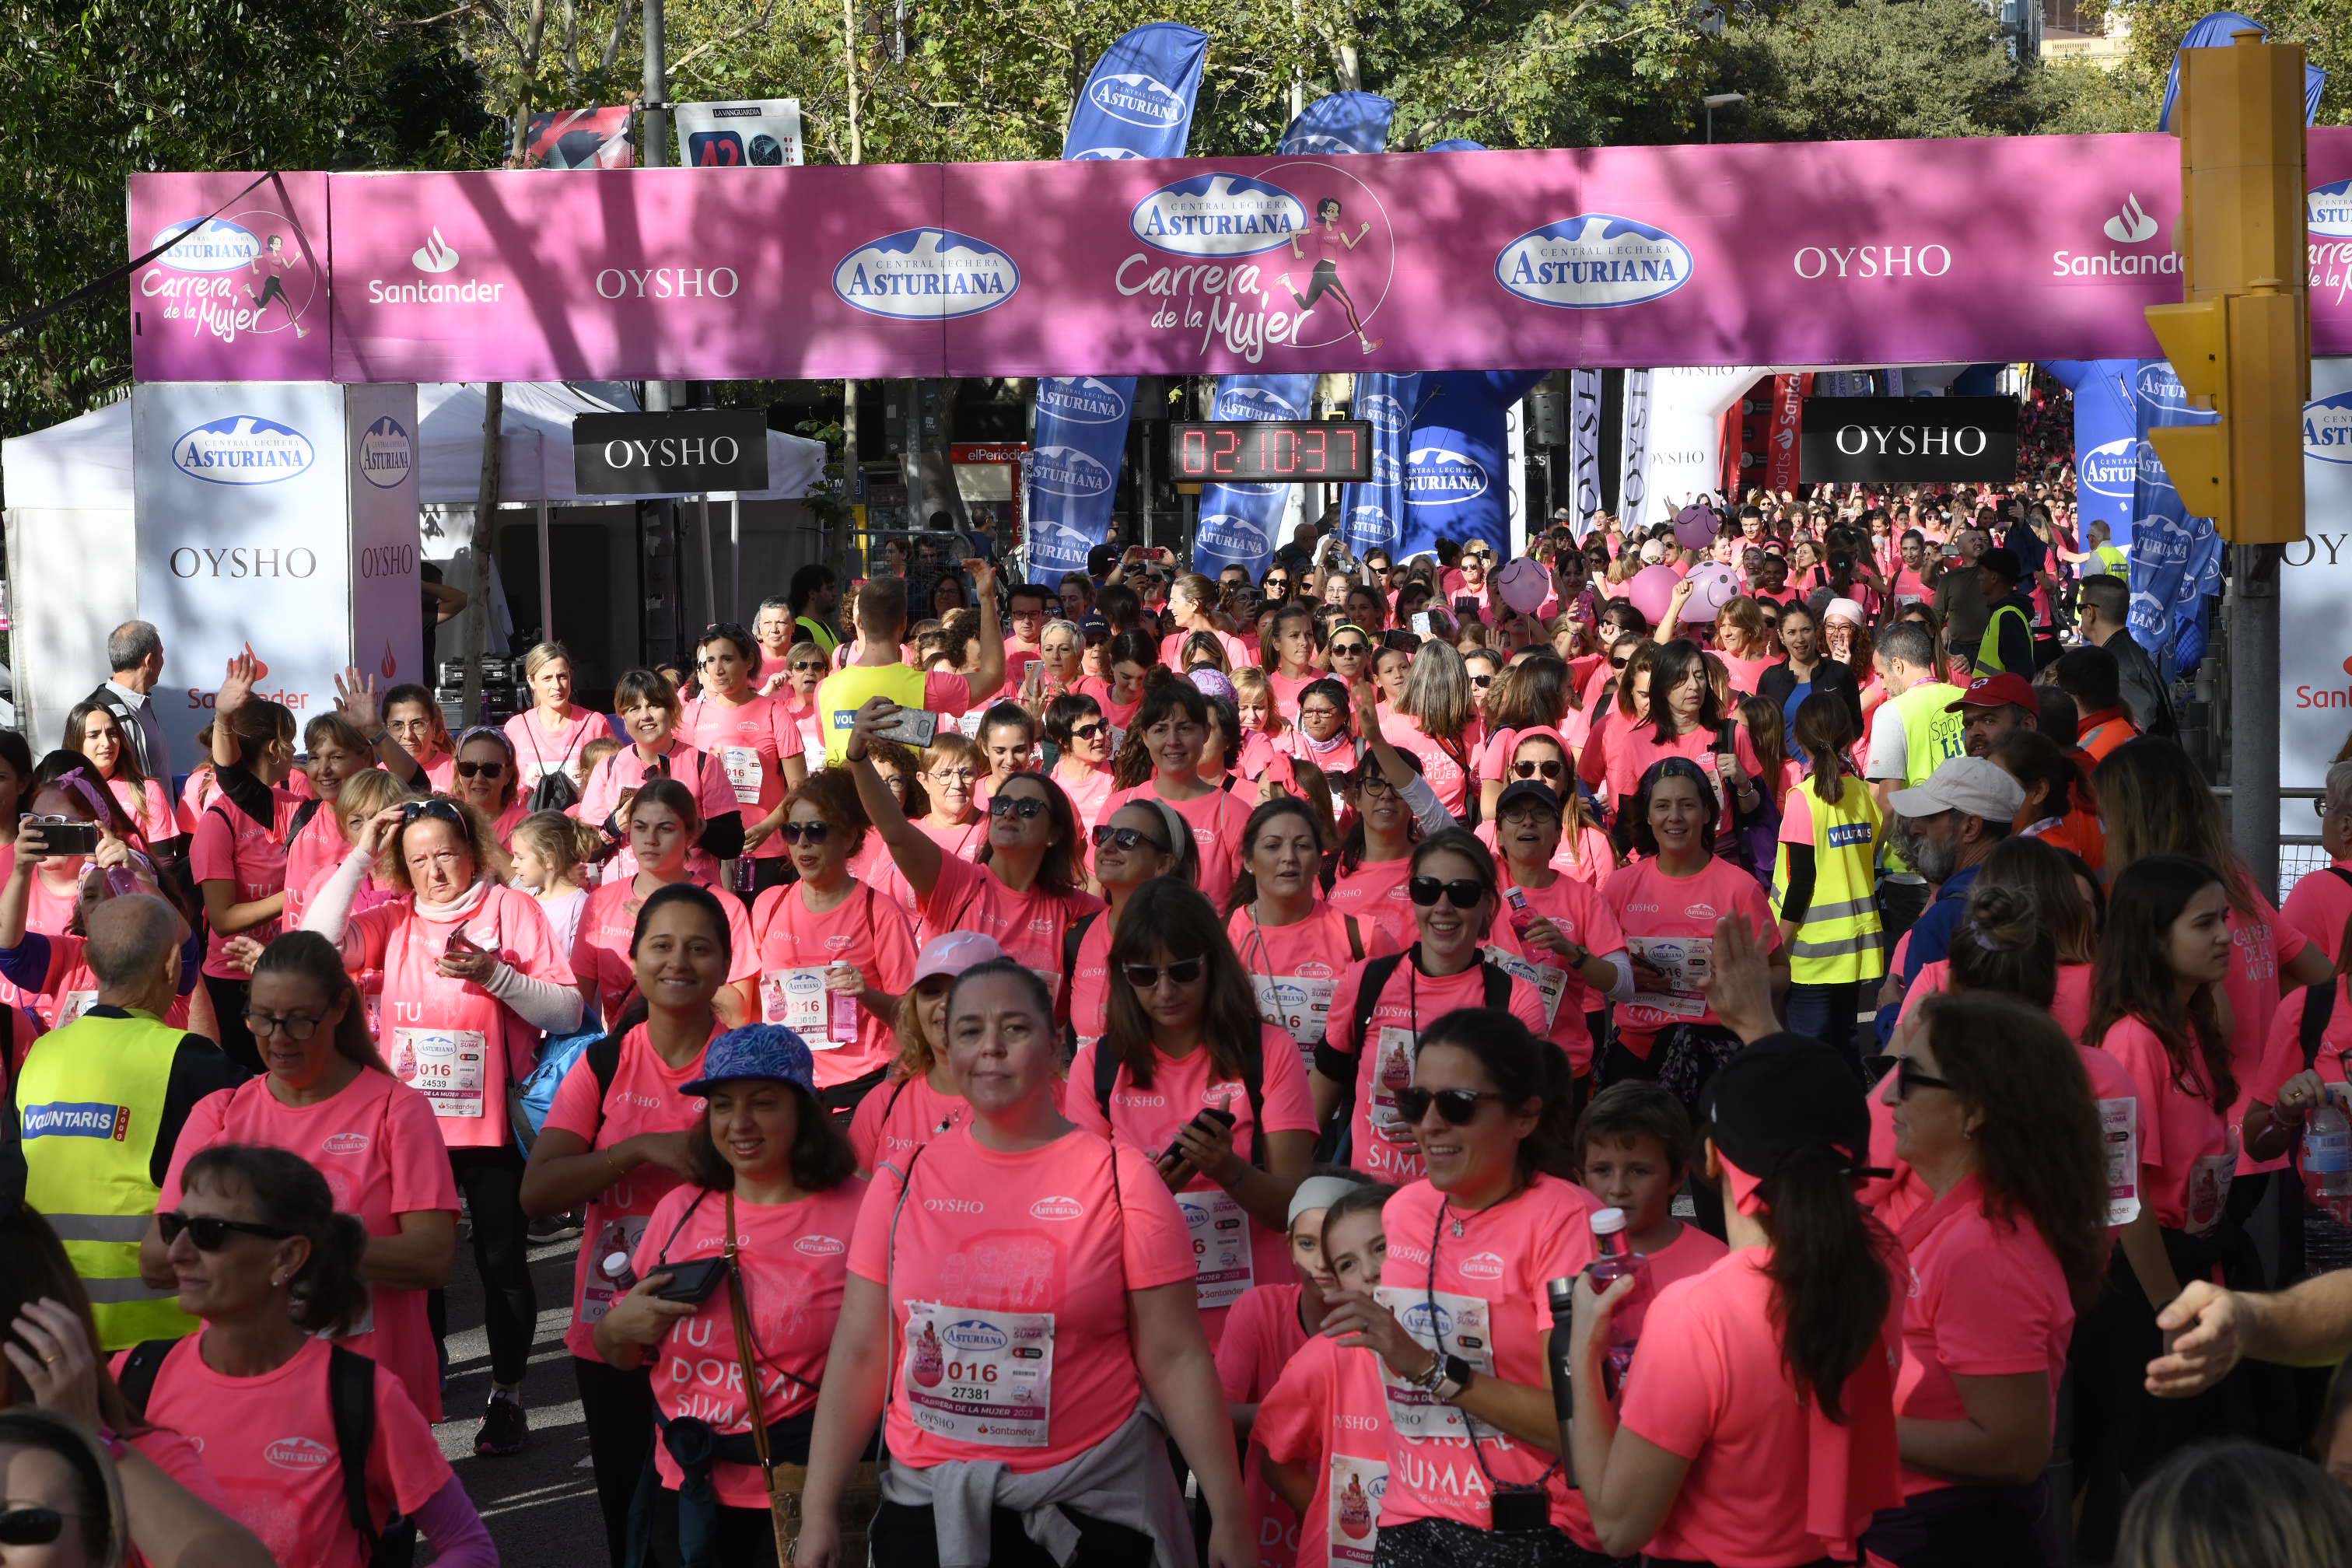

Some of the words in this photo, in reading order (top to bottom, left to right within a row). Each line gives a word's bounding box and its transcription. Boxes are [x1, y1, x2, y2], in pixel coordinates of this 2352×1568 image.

[723, 107, 761, 117] VANGUARDIA
[1096, 83, 1178, 121] ASTURIANA
[1171, 201, 1227, 212] CENTRAL
[1233, 200, 1288, 211] LECHERA
[1144, 206, 1293, 236] ASTURIANA
[1541, 247, 1602, 257] CENTRAL
[1608, 245, 1671, 255] LECHERA
[1794, 245, 1952, 278] OYSHO
[876, 260, 934, 269] CENTRAL
[940, 259, 999, 268] LECHERA
[1115, 253, 1261, 296] Carrera
[1510, 251, 1678, 285] ASTURIANA
[2053, 250, 2184, 277] Santand
[141, 268, 233, 297] Carrera
[596, 267, 739, 299] OYSHO
[848, 263, 1004, 296] ASTURIANA
[2326, 265, 2340, 287] la
[369, 279, 504, 303] Santander
[163, 299, 180, 319] de
[184, 299, 197, 319] la
[194, 295, 267, 343] Mujer
[1150, 298, 1178, 328] de
[1184, 296, 1203, 328] la
[1199, 290, 1315, 364] Mujer
[1036, 383, 1116, 418] ASTURIANA
[1780, 372, 1801, 425] Santa
[1577, 369, 1598, 520] OYSH
[1625, 369, 1648, 506] OYSH
[1836, 425, 1986, 457] OYSHO
[184, 441, 304, 467] ASTURIANA
[363, 443, 409, 471] ASTURIANA
[604, 436, 739, 468] OYSHO
[968, 447, 1020, 462] elPeriódi
[1184, 430, 1357, 473] 02:10:37
[1033, 464, 1103, 490] STURIANA
[2087, 460, 2136, 482] ASTU
[1405, 474, 1480, 492] STURIANA
[169, 546, 317, 579] OYSHO
[361, 544, 413, 579] OYSHO
[835, 715, 855, 724] VOL
[1930, 714, 1963, 741] Spor
[1424, 770, 1458, 779] MUJER
[1426, 762, 1440, 771] DE
[1444, 761, 1456, 770] LA
[247, 883, 272, 898] TU
[1331, 888, 1361, 899] OYSHO
[1627, 903, 1660, 912] OYSHO
[789, 981, 819, 991] ASTURIANA
[394, 1001, 422, 1022] TU
[420, 1044, 454, 1053] ASTURIANA
[420, 1063, 451, 1077] 016
[422, 1080, 446, 1088] 24539
[1115, 1092, 1164, 1108] OYSHO
[116, 1108, 129, 1140] 2000
[325, 1136, 368, 1151] ASTURIANA
[923, 1199, 984, 1214] OYSHO
[1034, 1203, 1080, 1216] ASTURIANA
[1213, 1203, 1238, 1213] SUMA
[697, 1234, 751, 1251] OYSO
[797, 1241, 842, 1254] ASTURIANA
[1205, 1287, 1244, 1299] Santander
[673, 1315, 713, 1349] TU
[947, 1329, 1003, 1346] ASTURIANA
[1013, 1331, 1043, 1339] SUMA
[947, 1361, 998, 1383] 016
[951, 1386, 990, 1401] 27381
[921, 1396, 954, 1410] CARRERA
[981, 1407, 1011, 1416] MUJER
[920, 1410, 955, 1430] OYSHO
[989, 1425, 1037, 1437] Santander
[1333, 1414, 1379, 1431] YSHO
[269, 1445, 330, 1466] ASTURIANA
[1399, 1450, 1487, 1496] SUMA
